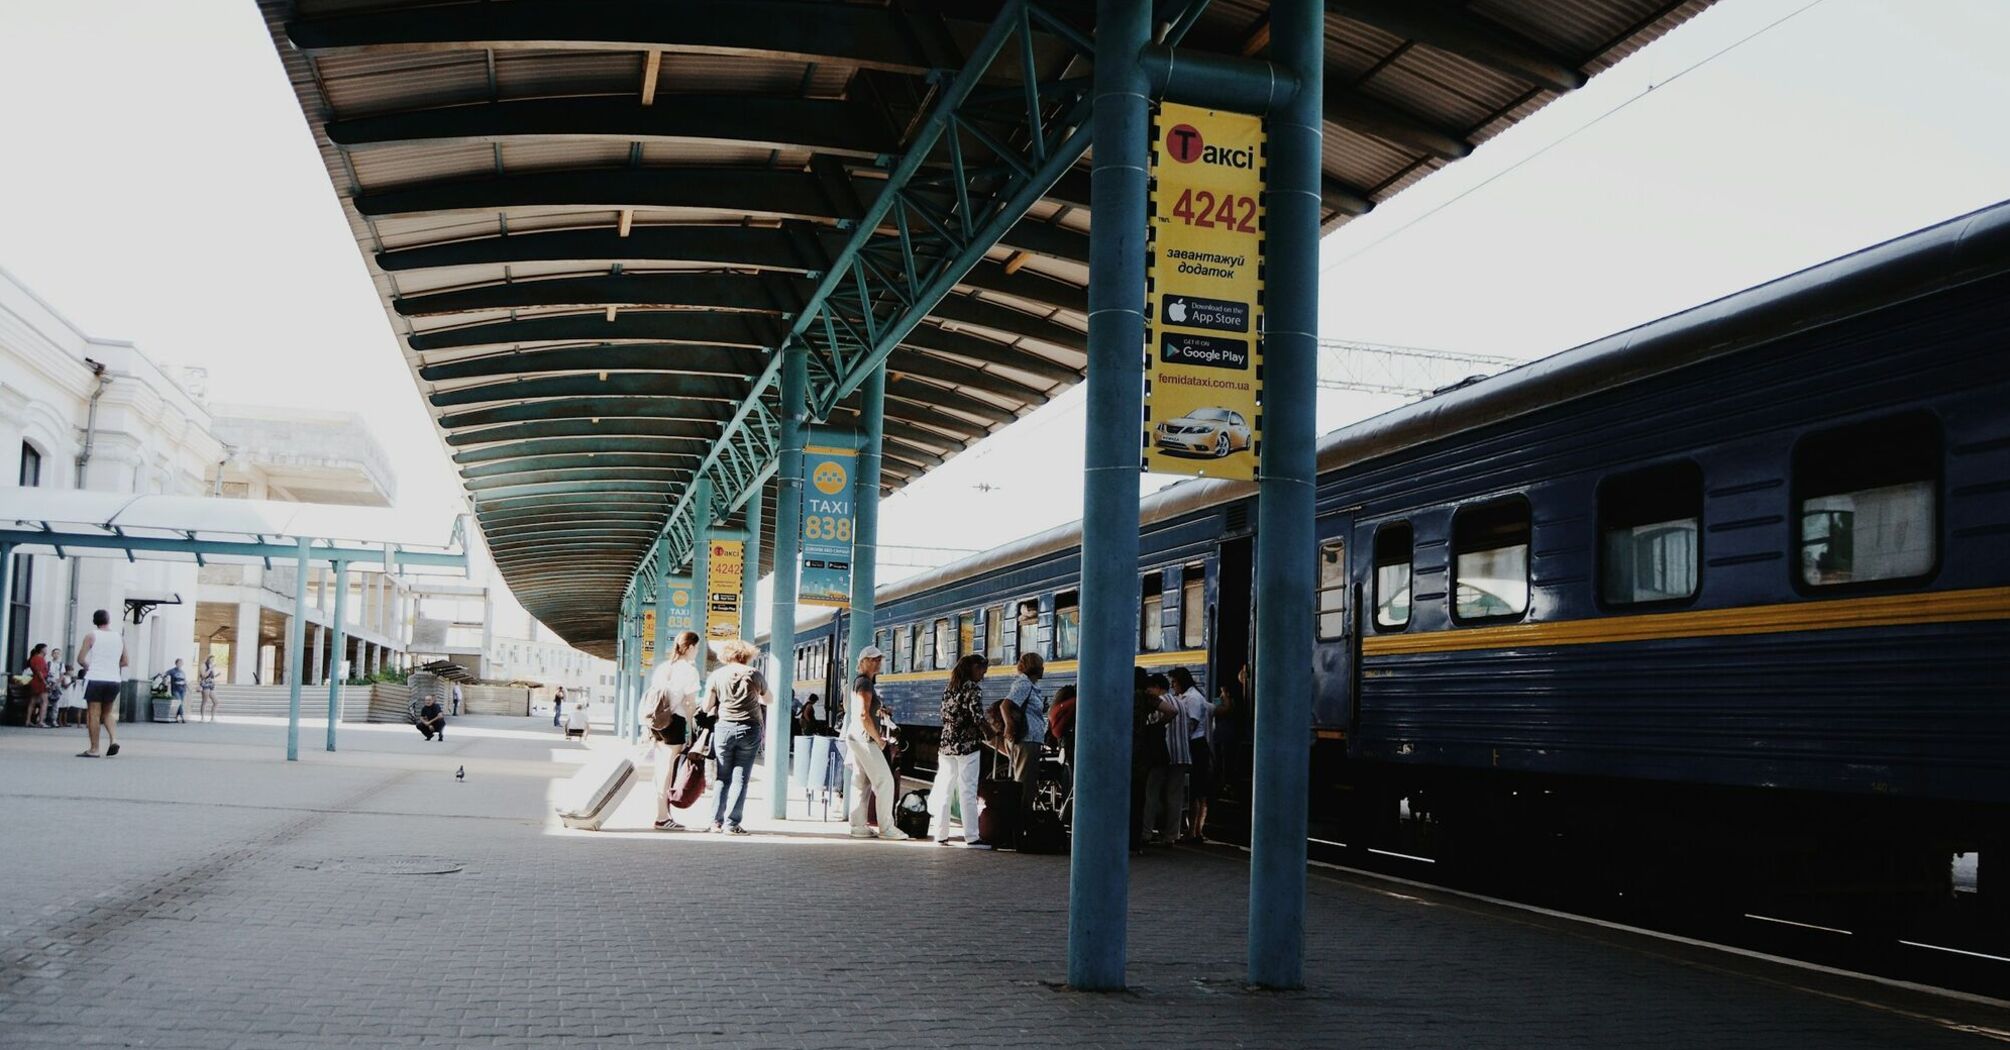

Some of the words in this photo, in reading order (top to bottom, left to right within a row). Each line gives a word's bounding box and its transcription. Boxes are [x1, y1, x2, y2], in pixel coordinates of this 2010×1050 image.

[1174, 129, 1254, 170] Таксі
[1172, 188, 1257, 234] 4242
[1167, 248, 1245, 268] завантажуй
[1178, 261, 1234, 279] додаток
[1191, 302, 1223, 312] Download
[1192, 310, 1213, 325] App
[1215, 313, 1241, 326] Store
[1183, 338, 1194, 346] GET
[1183, 346, 1221, 363] Google
[1222, 350, 1245, 365] Play
[1158, 373, 1250, 391] femidataxi.com.ua
[809, 499, 848, 515] TAXI
[805, 515, 852, 542] 838
[715, 563, 740, 575] 4242
